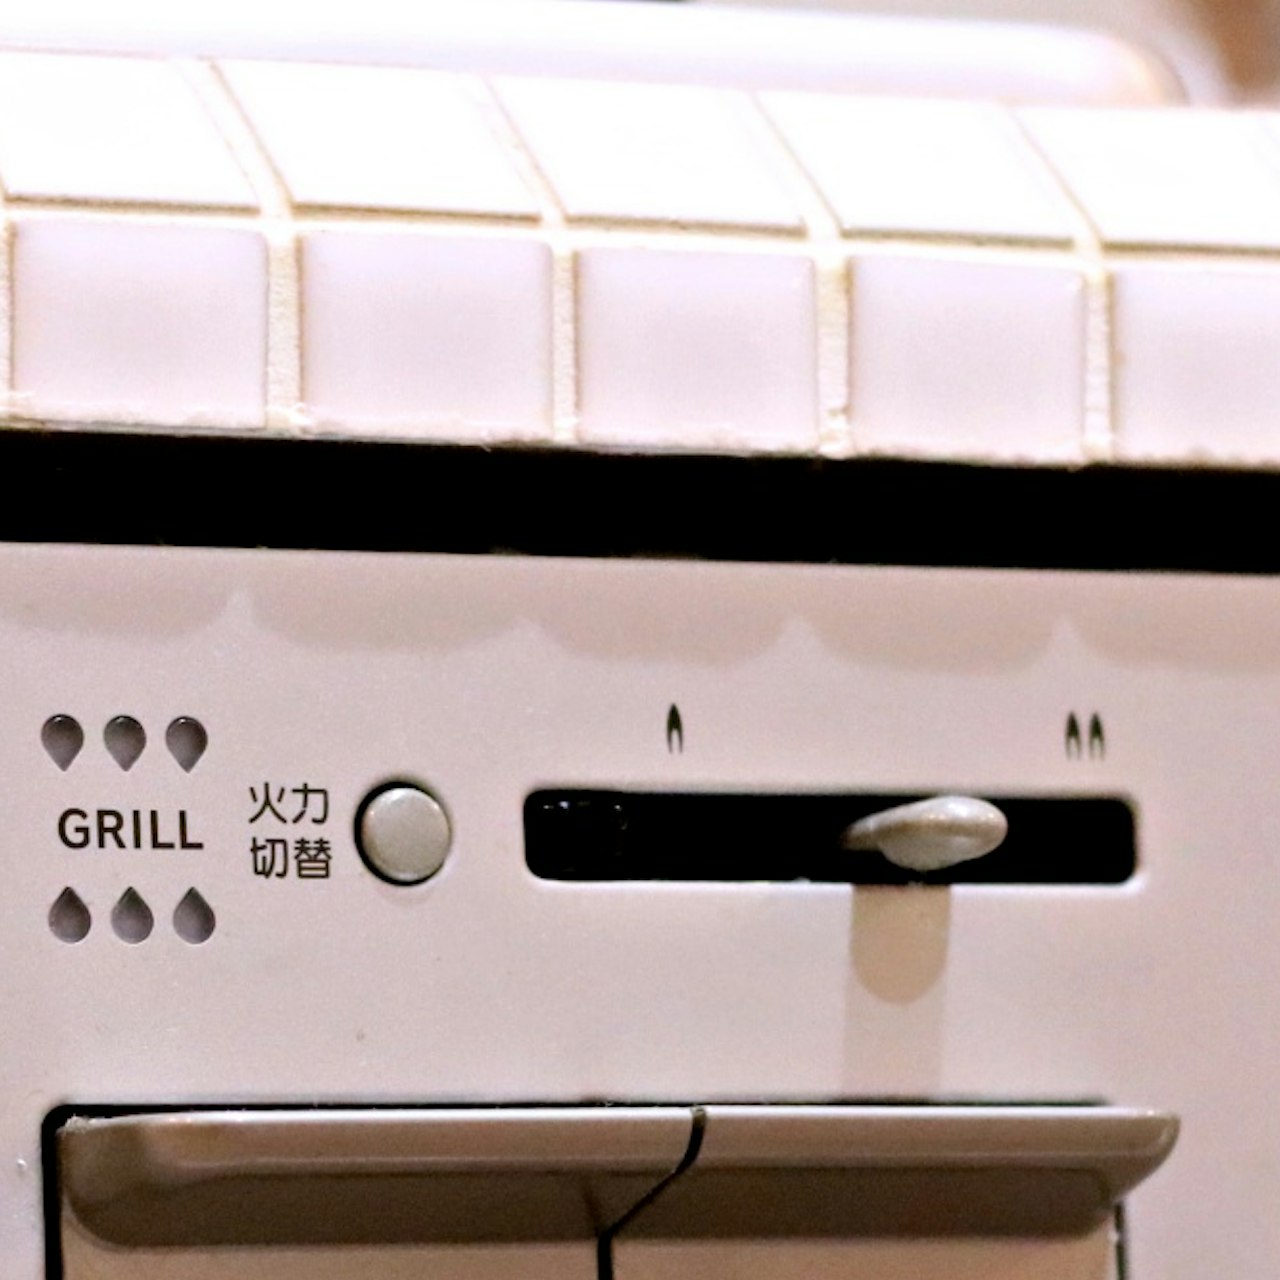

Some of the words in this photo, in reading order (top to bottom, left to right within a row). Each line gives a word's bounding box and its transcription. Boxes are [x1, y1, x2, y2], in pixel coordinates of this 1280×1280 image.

[248, 782, 329, 825] 火力
[58, 808, 204, 850] GRILL
[249, 837, 332, 879] 切替
